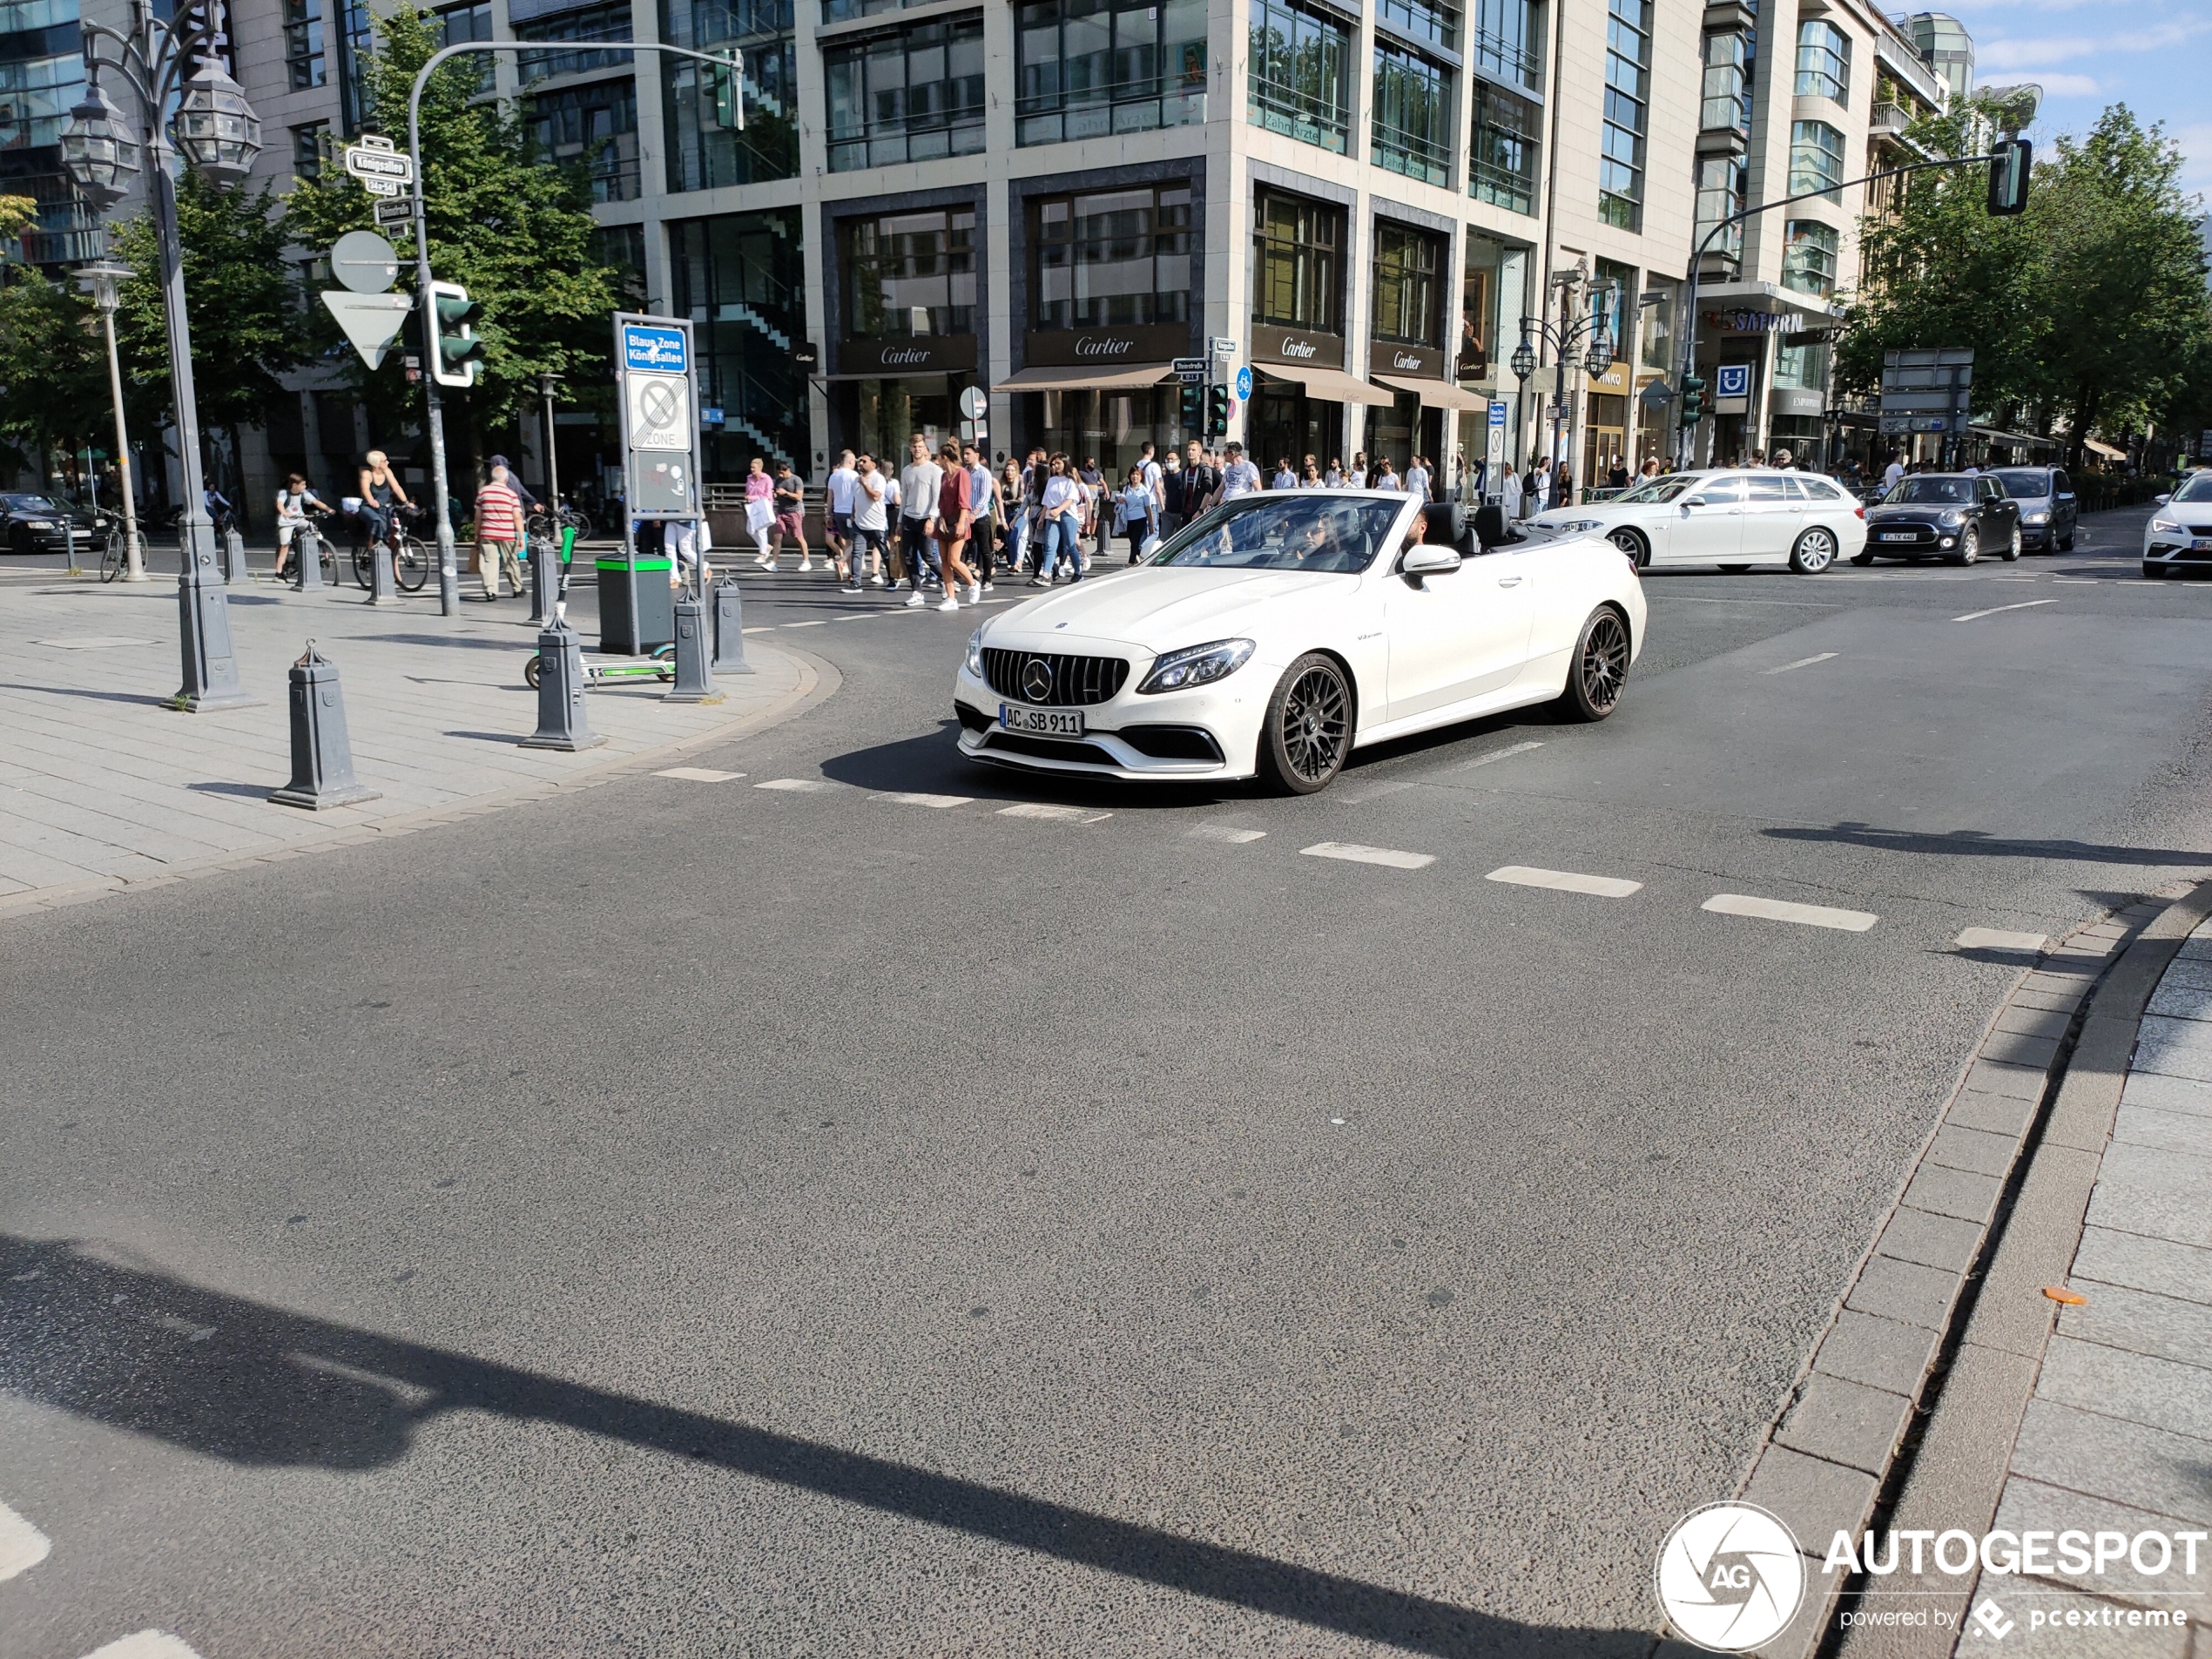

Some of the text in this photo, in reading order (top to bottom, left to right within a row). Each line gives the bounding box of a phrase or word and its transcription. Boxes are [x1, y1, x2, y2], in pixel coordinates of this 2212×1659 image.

[356, 155, 404, 173] Königsallee
[1736, 313, 1803, 332] SATURN
[628, 334, 681, 349] Blaue Zone
[1075, 336, 1134, 355] Cartier
[1282, 336, 1317, 359] Cartier
[880, 346, 931, 364] Cartier
[1393, 350, 1421, 370] Cartier
[646, 432, 676, 446] ZONE
[1007, 708, 1079, 733] AC SB 911
